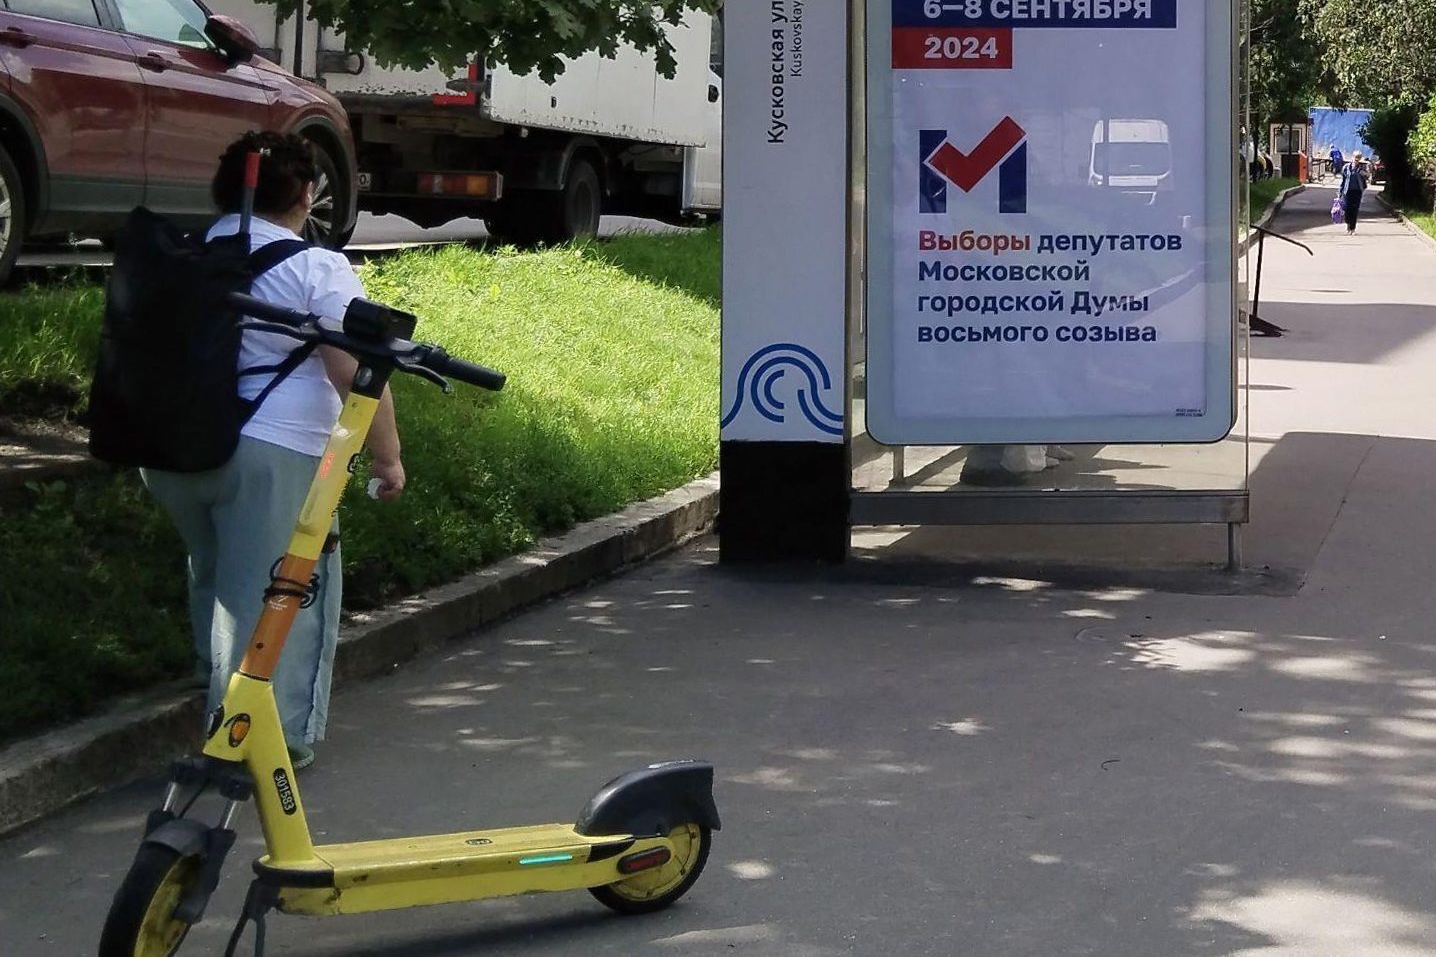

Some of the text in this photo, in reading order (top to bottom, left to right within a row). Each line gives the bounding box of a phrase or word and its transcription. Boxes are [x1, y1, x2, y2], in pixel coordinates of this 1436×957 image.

[924, 36, 998, 59] 2024
[767, 29, 788, 144] Кусковская
[918, 230, 1183, 256] Выборы депутатов
[918, 259, 1090, 282] Московской
[918, 290, 1149, 317] городской Думы
[917, 325, 1157, 343] восьмого созыва
[275, 774, 295, 810] 301583
